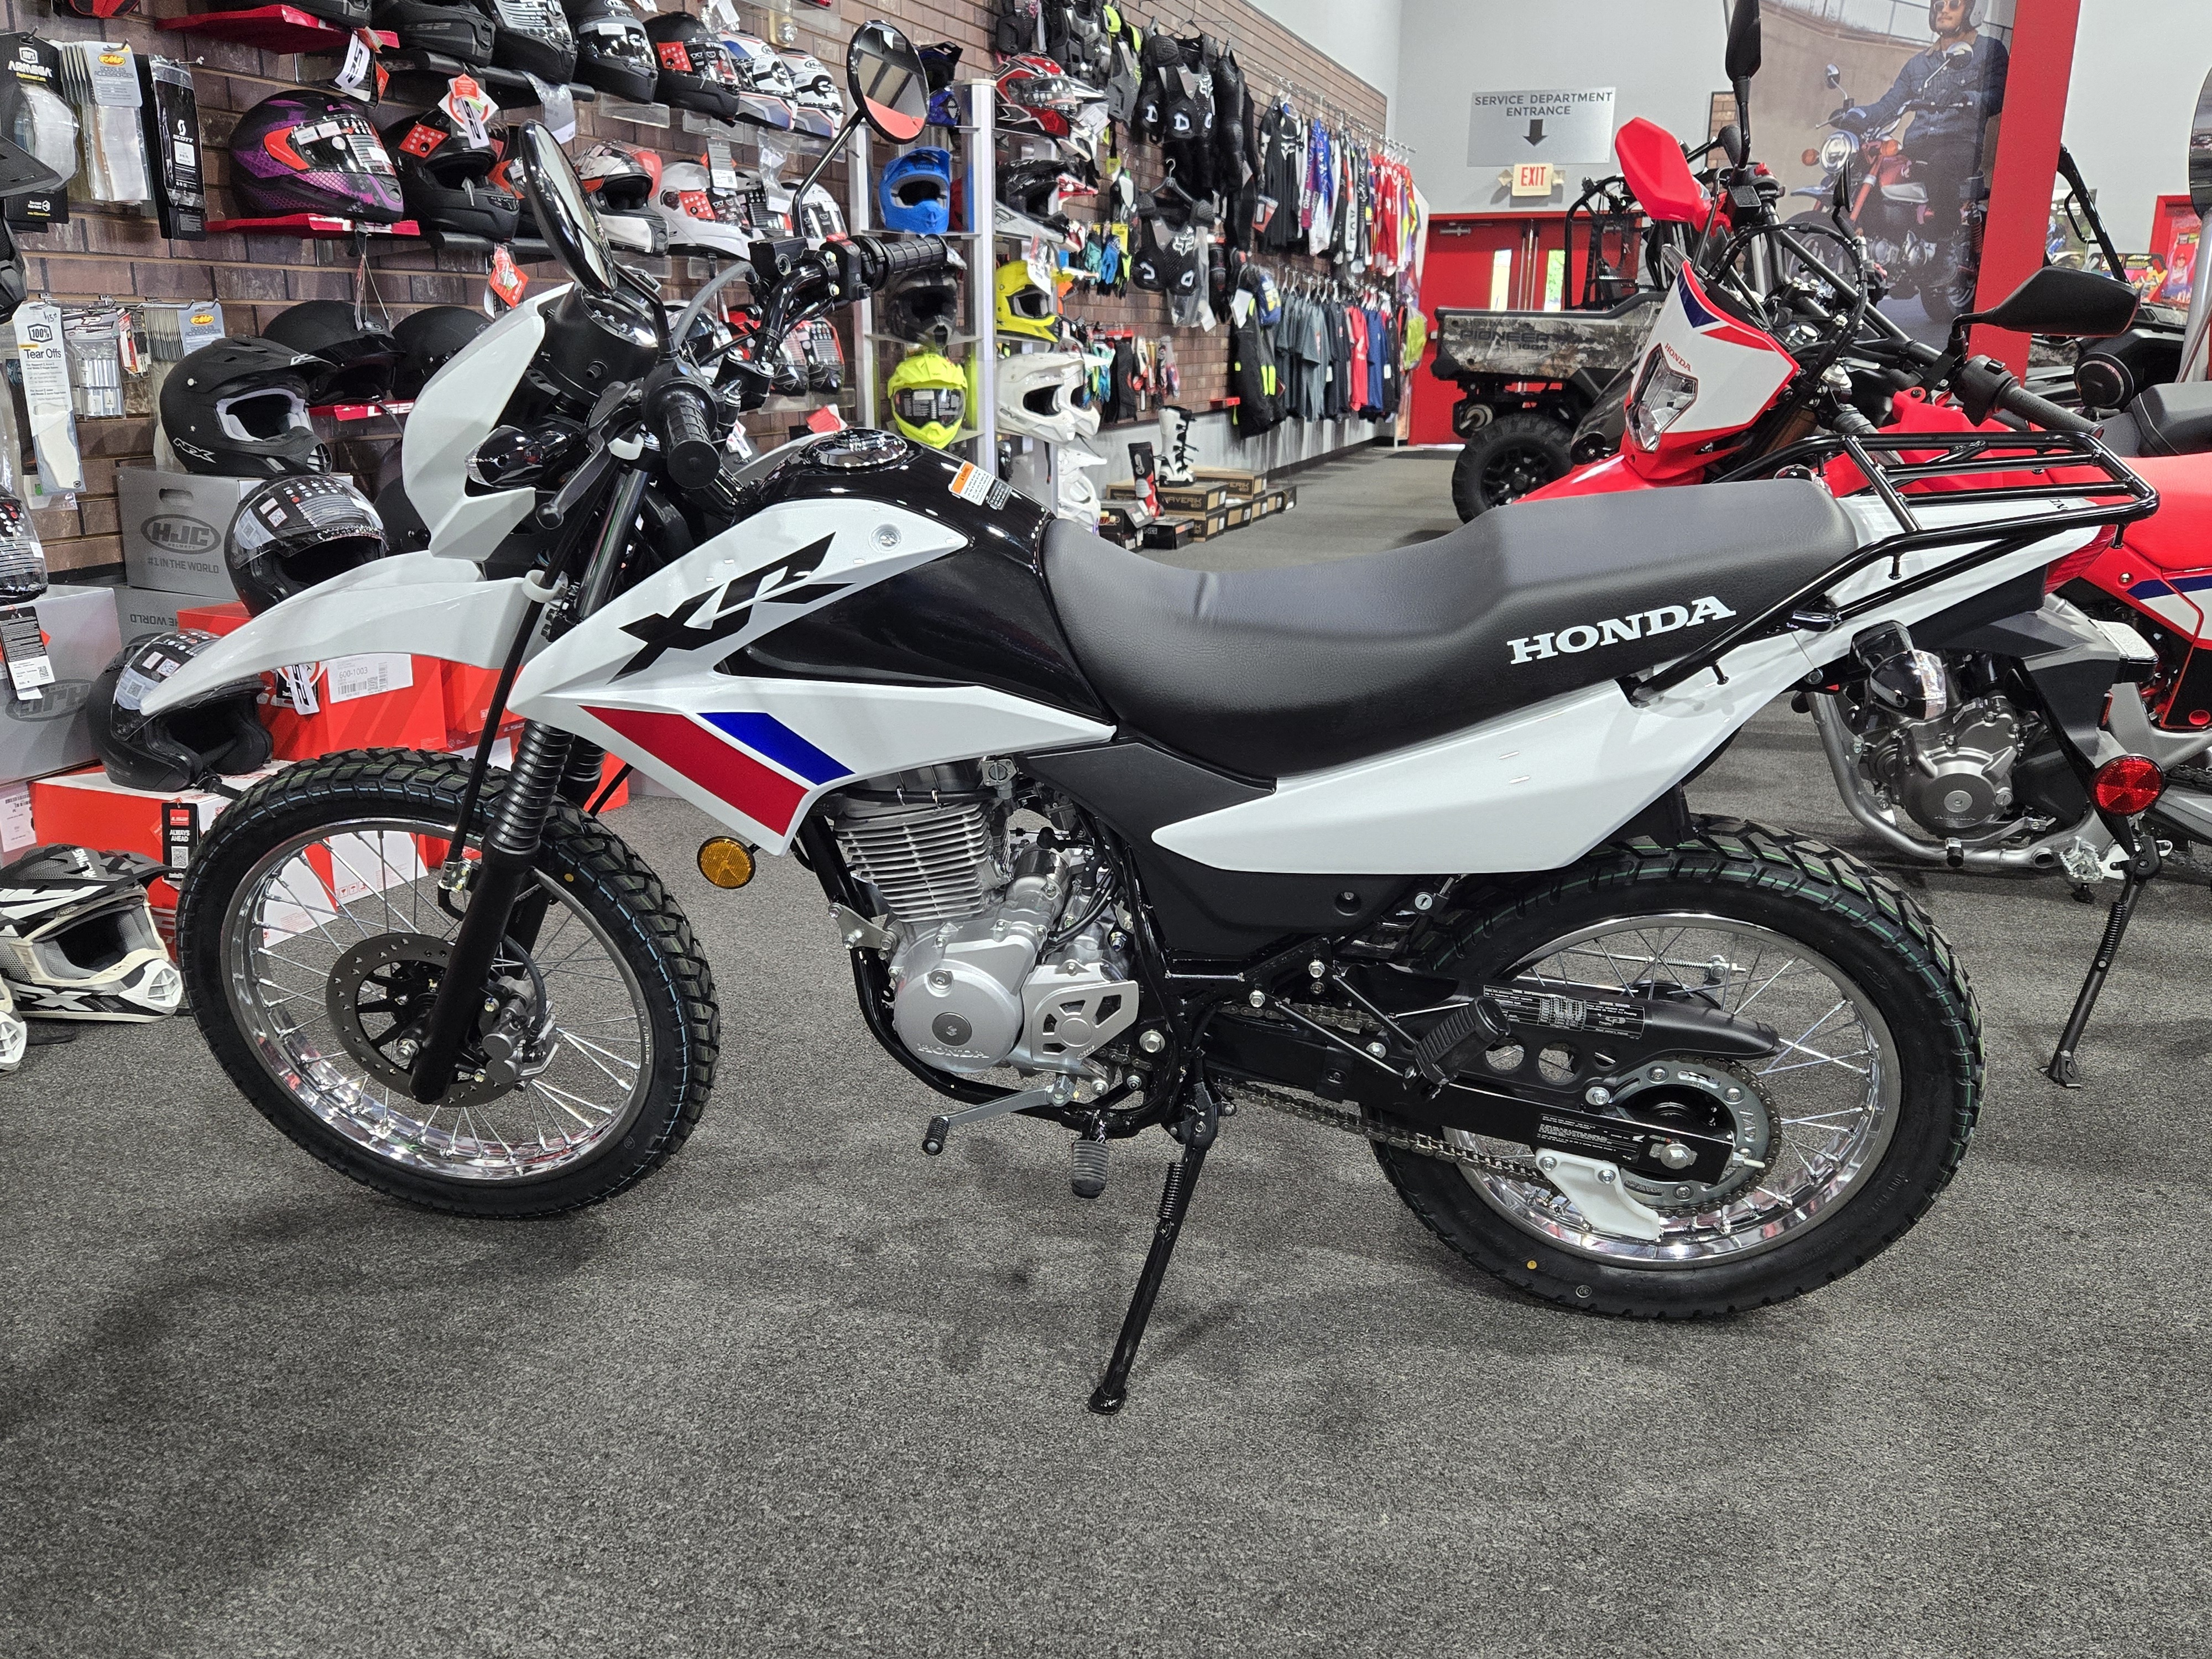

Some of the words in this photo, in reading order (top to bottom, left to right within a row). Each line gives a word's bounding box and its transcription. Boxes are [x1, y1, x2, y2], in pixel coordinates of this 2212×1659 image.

[1475, 95, 1524, 106] SERVICE
[1530, 92, 1613, 104] DEPARTMENT
[1506, 106, 1571, 117] ENTRANCE
[1521, 167, 1546, 186] EXIT
[32, 328, 50, 338] 100%
[1460, 329, 1550, 343] PIONEER
[24, 348, 44, 360] Tear
[46, 348, 62, 358] Offs
[1665, 342, 1691, 373] HONDA
[151, 522, 210, 546] HJC
[169, 559, 186, 570] THE
[187, 561, 220, 573] WORLD
[130, 614, 166, 626] WORLD
[1507, 596, 1736, 664] HONDA
[339, 666, 368, 679] 600-1003
[917, 1043, 990, 1058] HONDA
